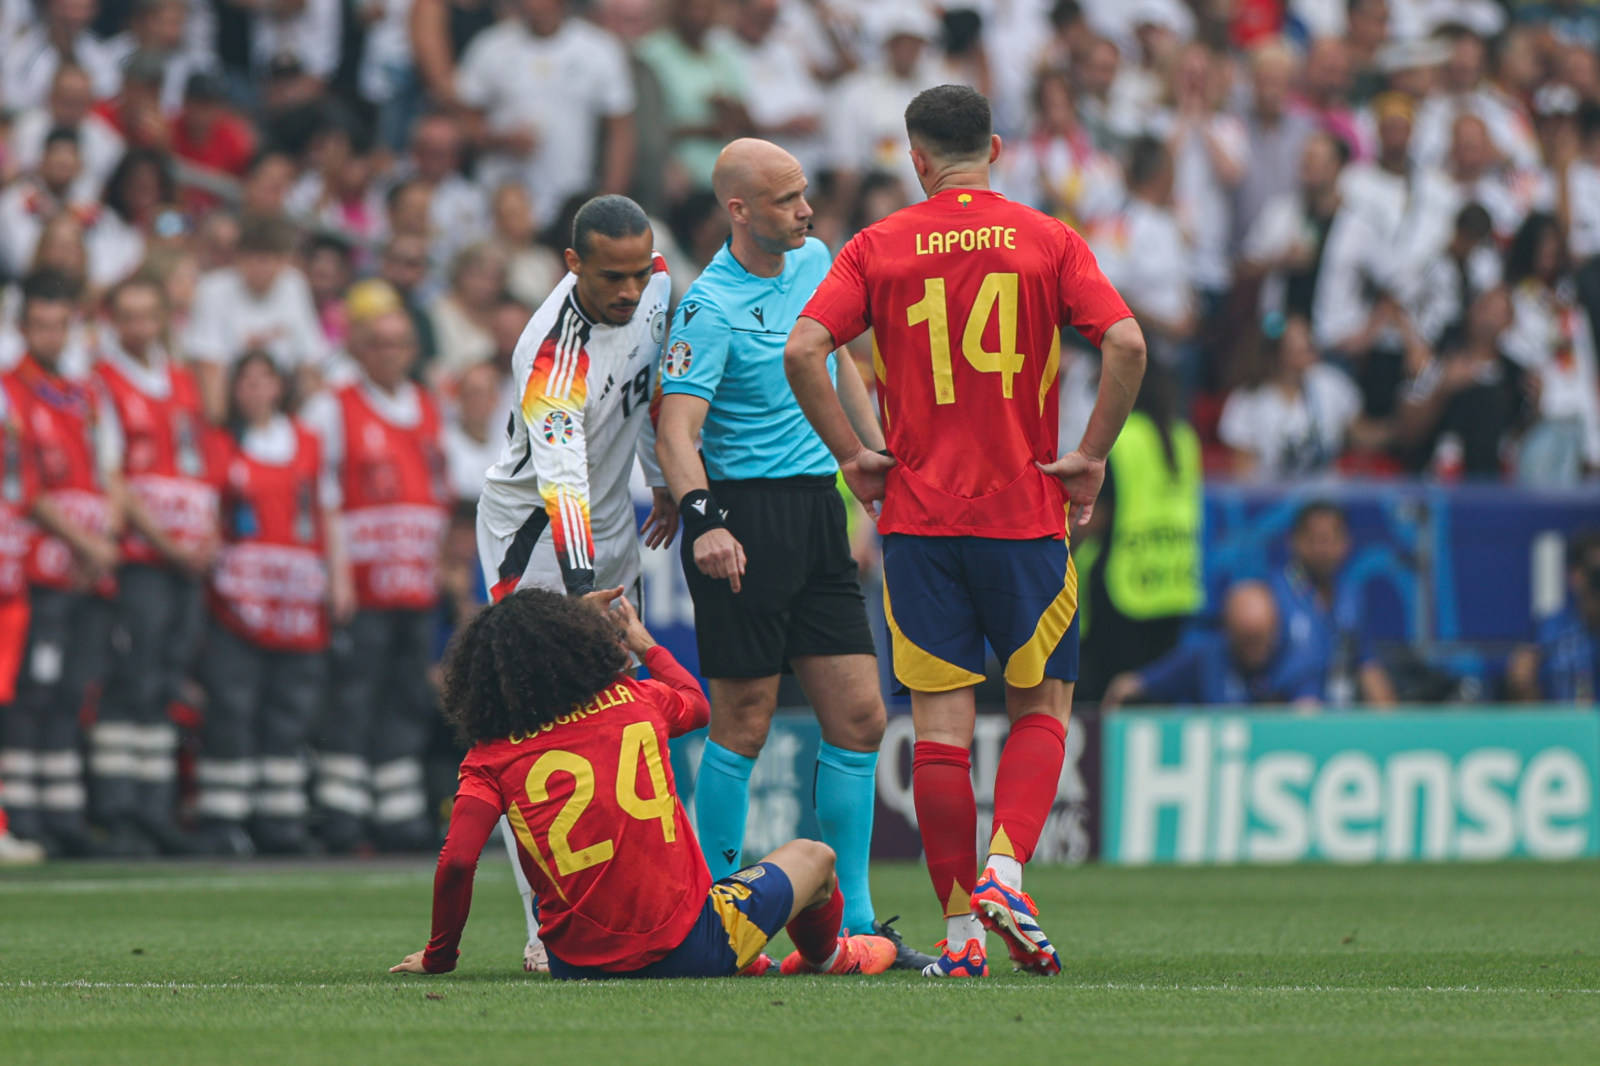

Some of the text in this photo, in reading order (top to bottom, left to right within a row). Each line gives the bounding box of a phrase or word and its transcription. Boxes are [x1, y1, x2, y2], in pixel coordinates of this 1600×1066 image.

[915, 225, 1017, 255] LAPORTE
[621, 364, 650, 419] 19
[906, 272, 1025, 405] 14
[525, 721, 676, 877] 24
[1117, 717, 1593, 863] Hisense
